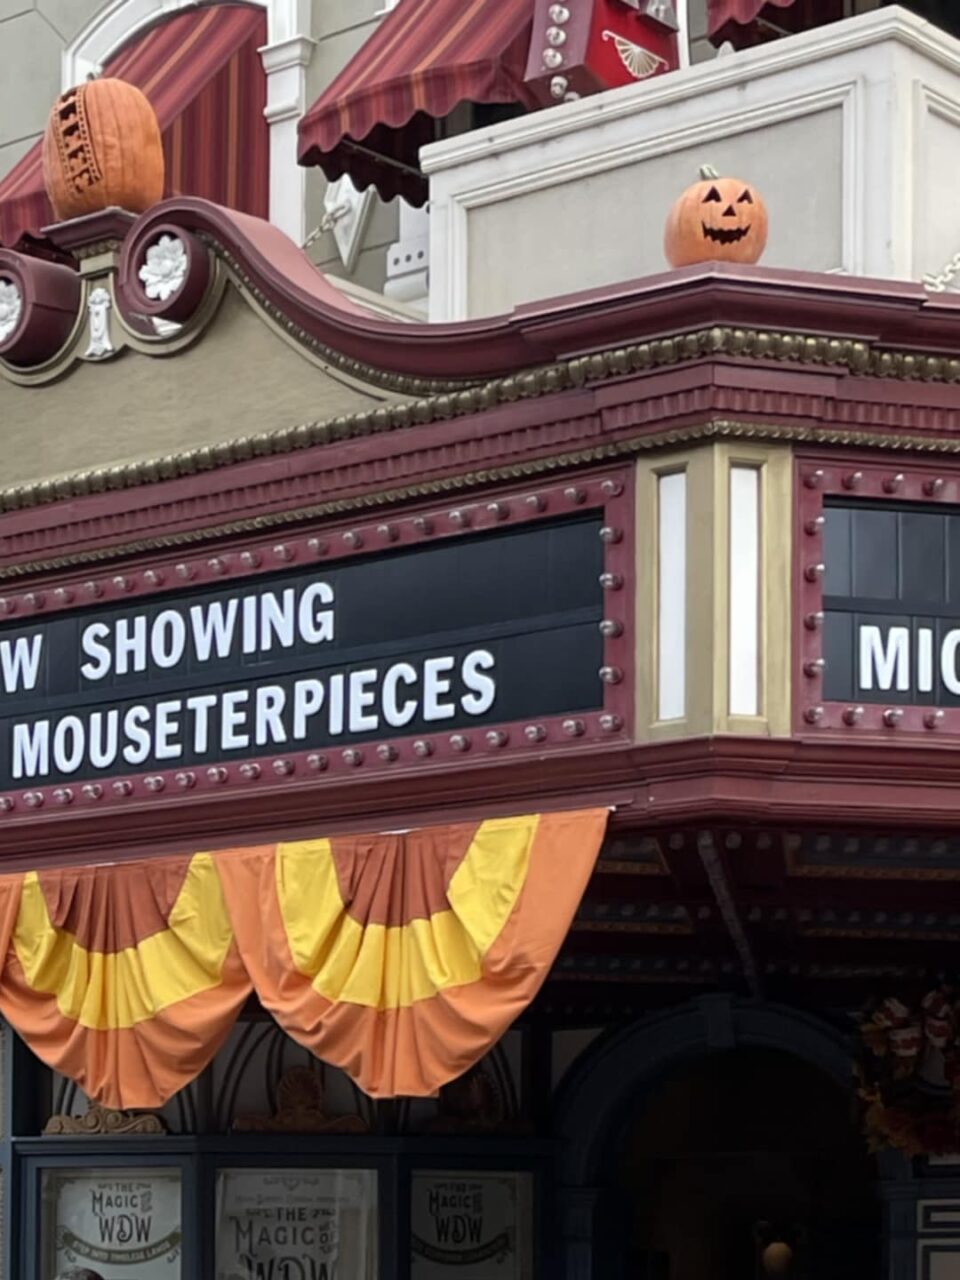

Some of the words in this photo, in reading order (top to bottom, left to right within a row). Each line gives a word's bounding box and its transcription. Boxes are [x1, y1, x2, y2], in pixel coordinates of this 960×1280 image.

[80, 581, 335, 681] SHOWING
[11, 650, 496, 778] MOUSETERPIECES
[91, 1189, 139, 1216] MAGIC
[115, 1183, 133, 1193] THE
[98, 1214, 152, 1243] WDW
[276, 1207, 307, 1222] THE
[435, 1214, 483, 1244] WDW
[229, 1216, 315, 1257] MAGIC
